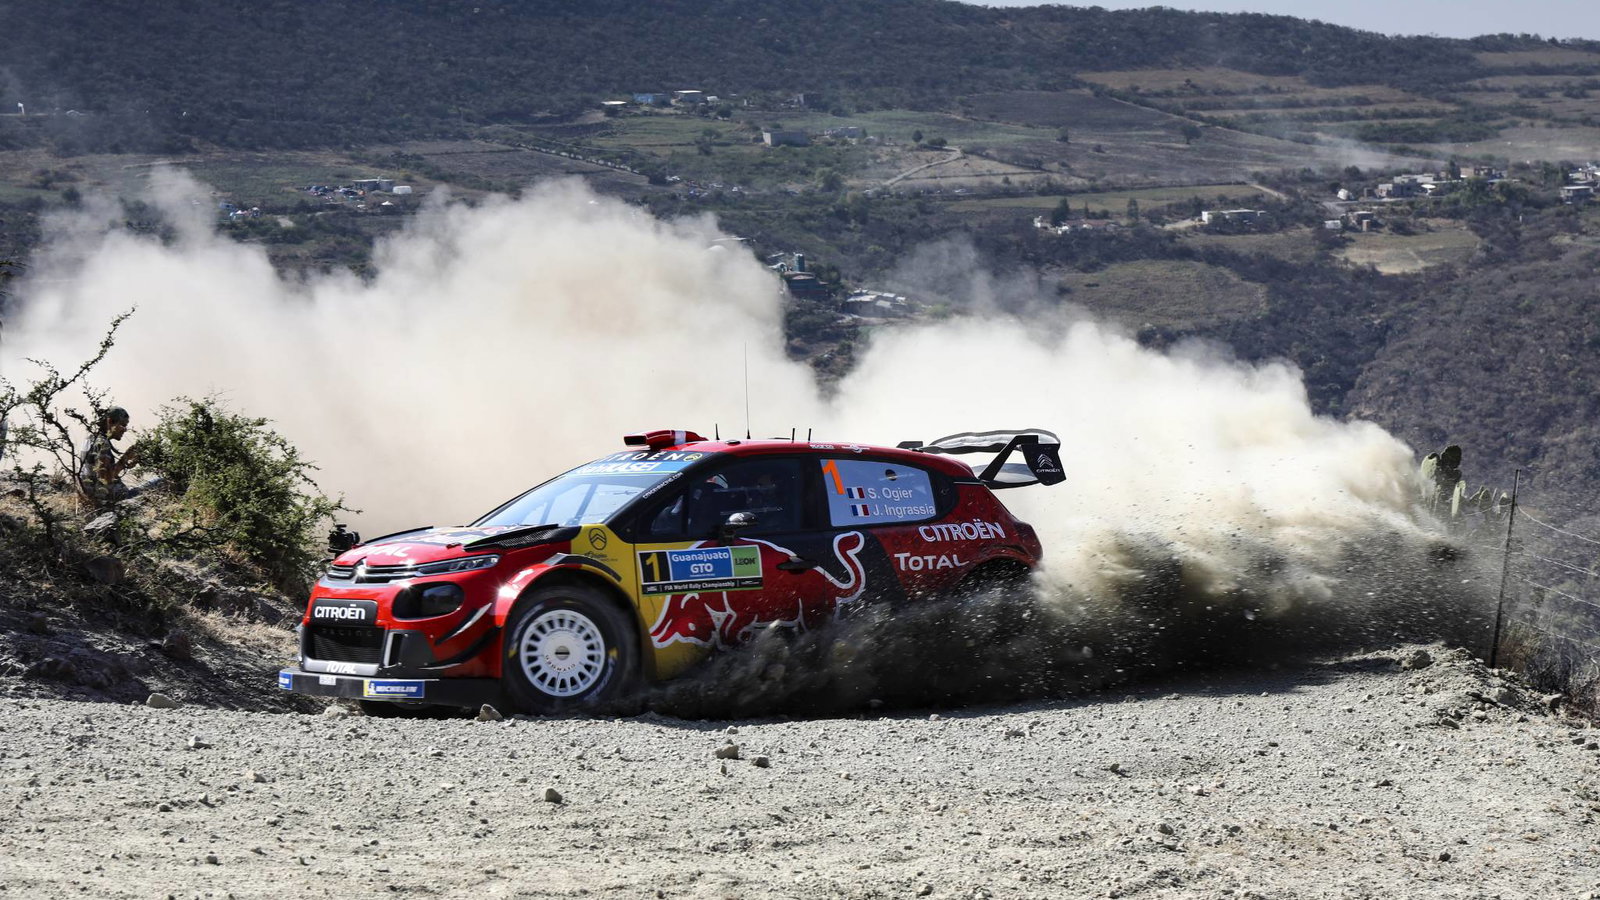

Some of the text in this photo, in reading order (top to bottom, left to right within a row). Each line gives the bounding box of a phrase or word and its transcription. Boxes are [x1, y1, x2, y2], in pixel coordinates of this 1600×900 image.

[822, 459, 845, 495] 1
[868, 487, 913, 501] S. Ogier
[873, 503, 936, 518] J. Ingrassia
[918, 518, 1006, 542] CITROËN
[671, 551, 729, 562] Guanajuato
[894, 552, 970, 571] TOTAL
[645, 553, 660, 582] 1
[690, 563, 714, 574] GTO
[702, 581, 735, 589] Championship
[314, 603, 366, 620] CITROËN
[326, 660, 357, 674] TOTAL
[376, 685, 418, 693] MICHELIN
